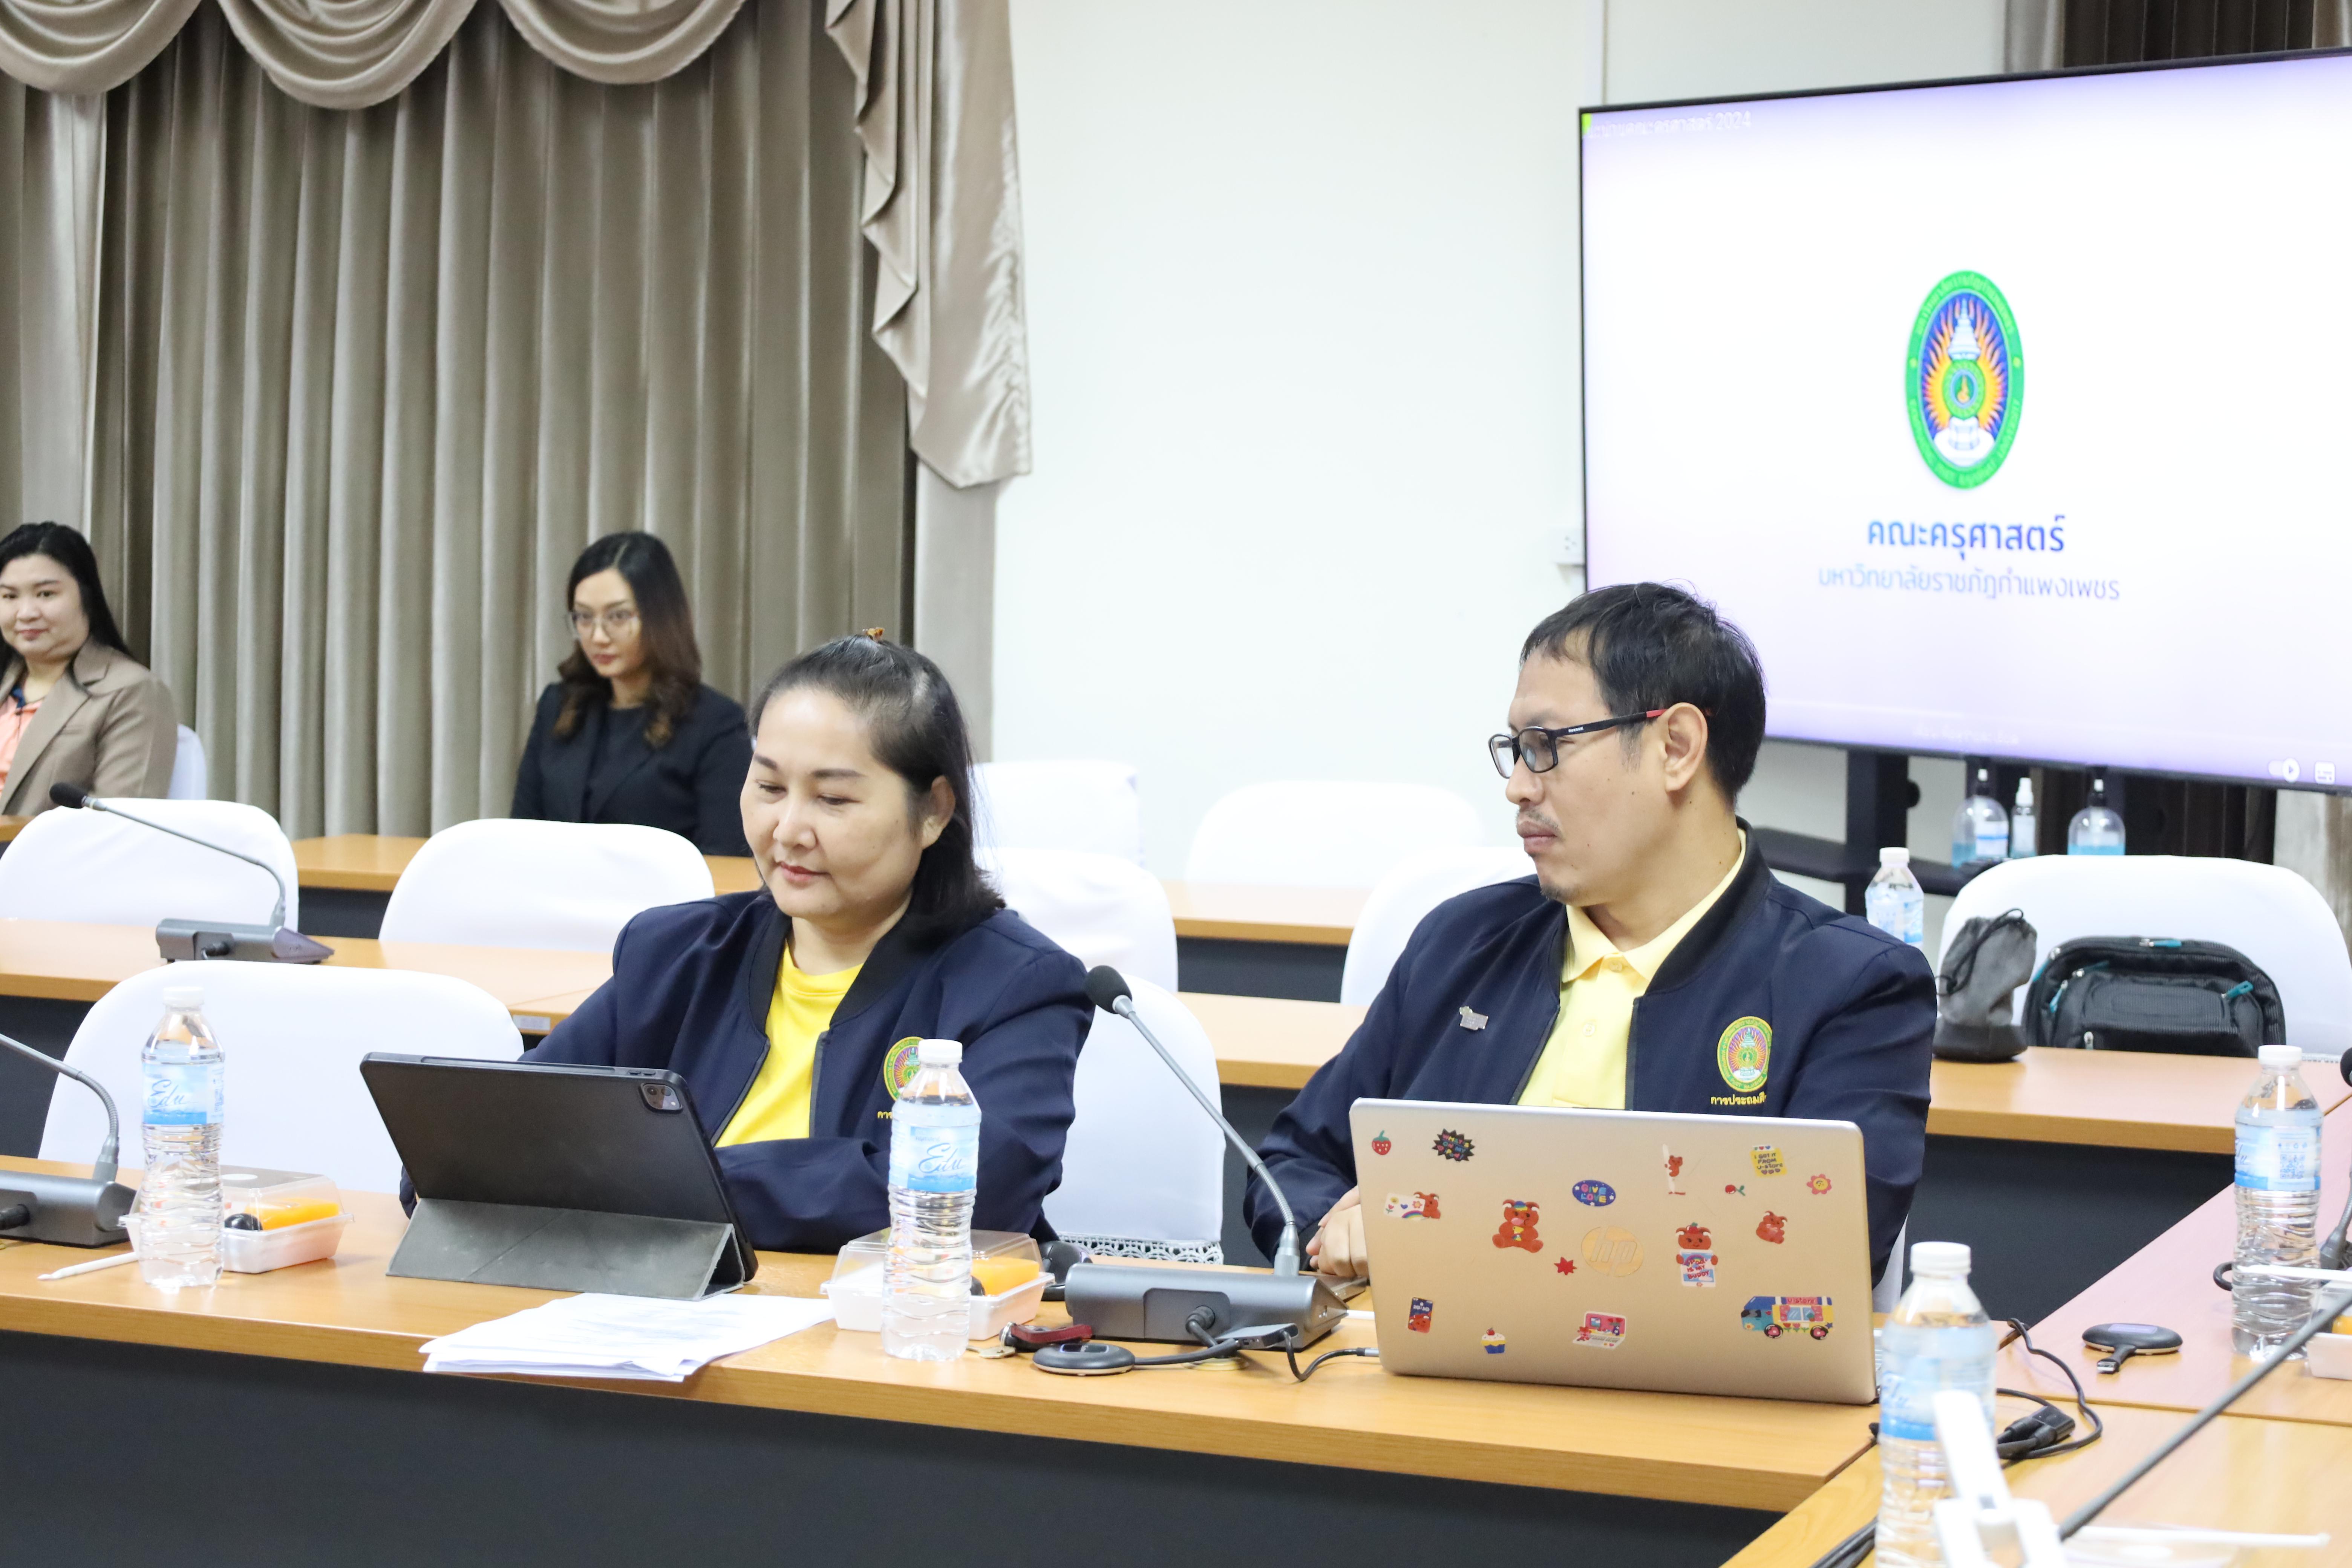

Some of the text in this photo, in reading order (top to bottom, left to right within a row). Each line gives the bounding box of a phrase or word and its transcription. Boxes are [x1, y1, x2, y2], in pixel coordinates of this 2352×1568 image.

[1715, 110, 1752, 129] 2024
[1868, 514, 2065, 560] คณะครุศาสตร์
[1819, 563, 2119, 600] มหาวิทยาลัยราชภัฏกำแพงเพชร
[147, 1079, 185, 1108] Edu
[918, 1142, 962, 1174] Edu
[1580, 1193, 1607, 1203] LOVE
[1581, 1184, 1607, 1195] GIVE
[1589, 1226, 1637, 1277] hp
[1687, 1270, 1709, 1279] BUDDY
